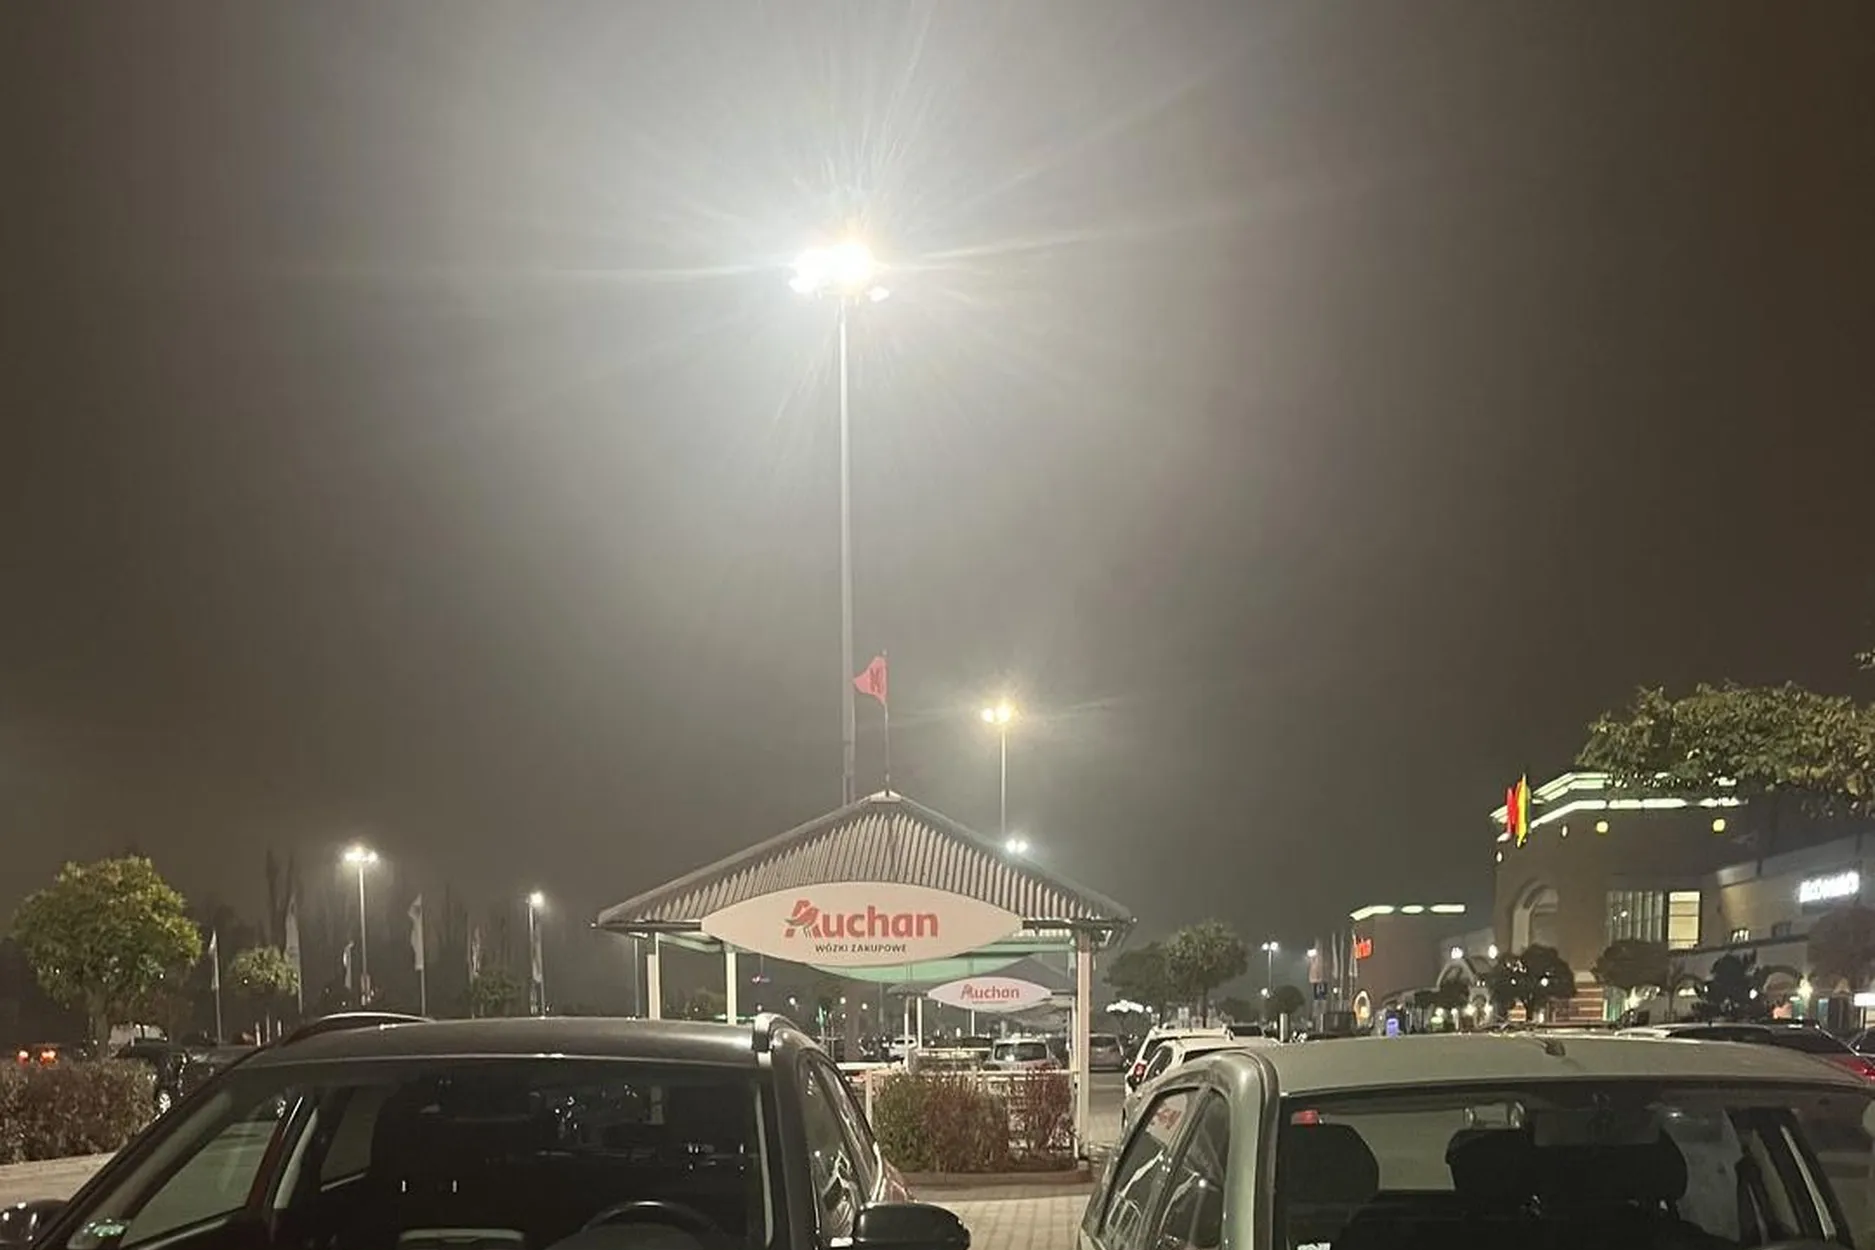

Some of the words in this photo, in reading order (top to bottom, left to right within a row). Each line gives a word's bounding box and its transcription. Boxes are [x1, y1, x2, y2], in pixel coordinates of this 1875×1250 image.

[785, 899, 939, 938] Auchan
[815, 943, 849, 953] WÓZKI
[851, 943, 907, 953] ZAKUPOWE
[960, 984, 1020, 999] Auchan
